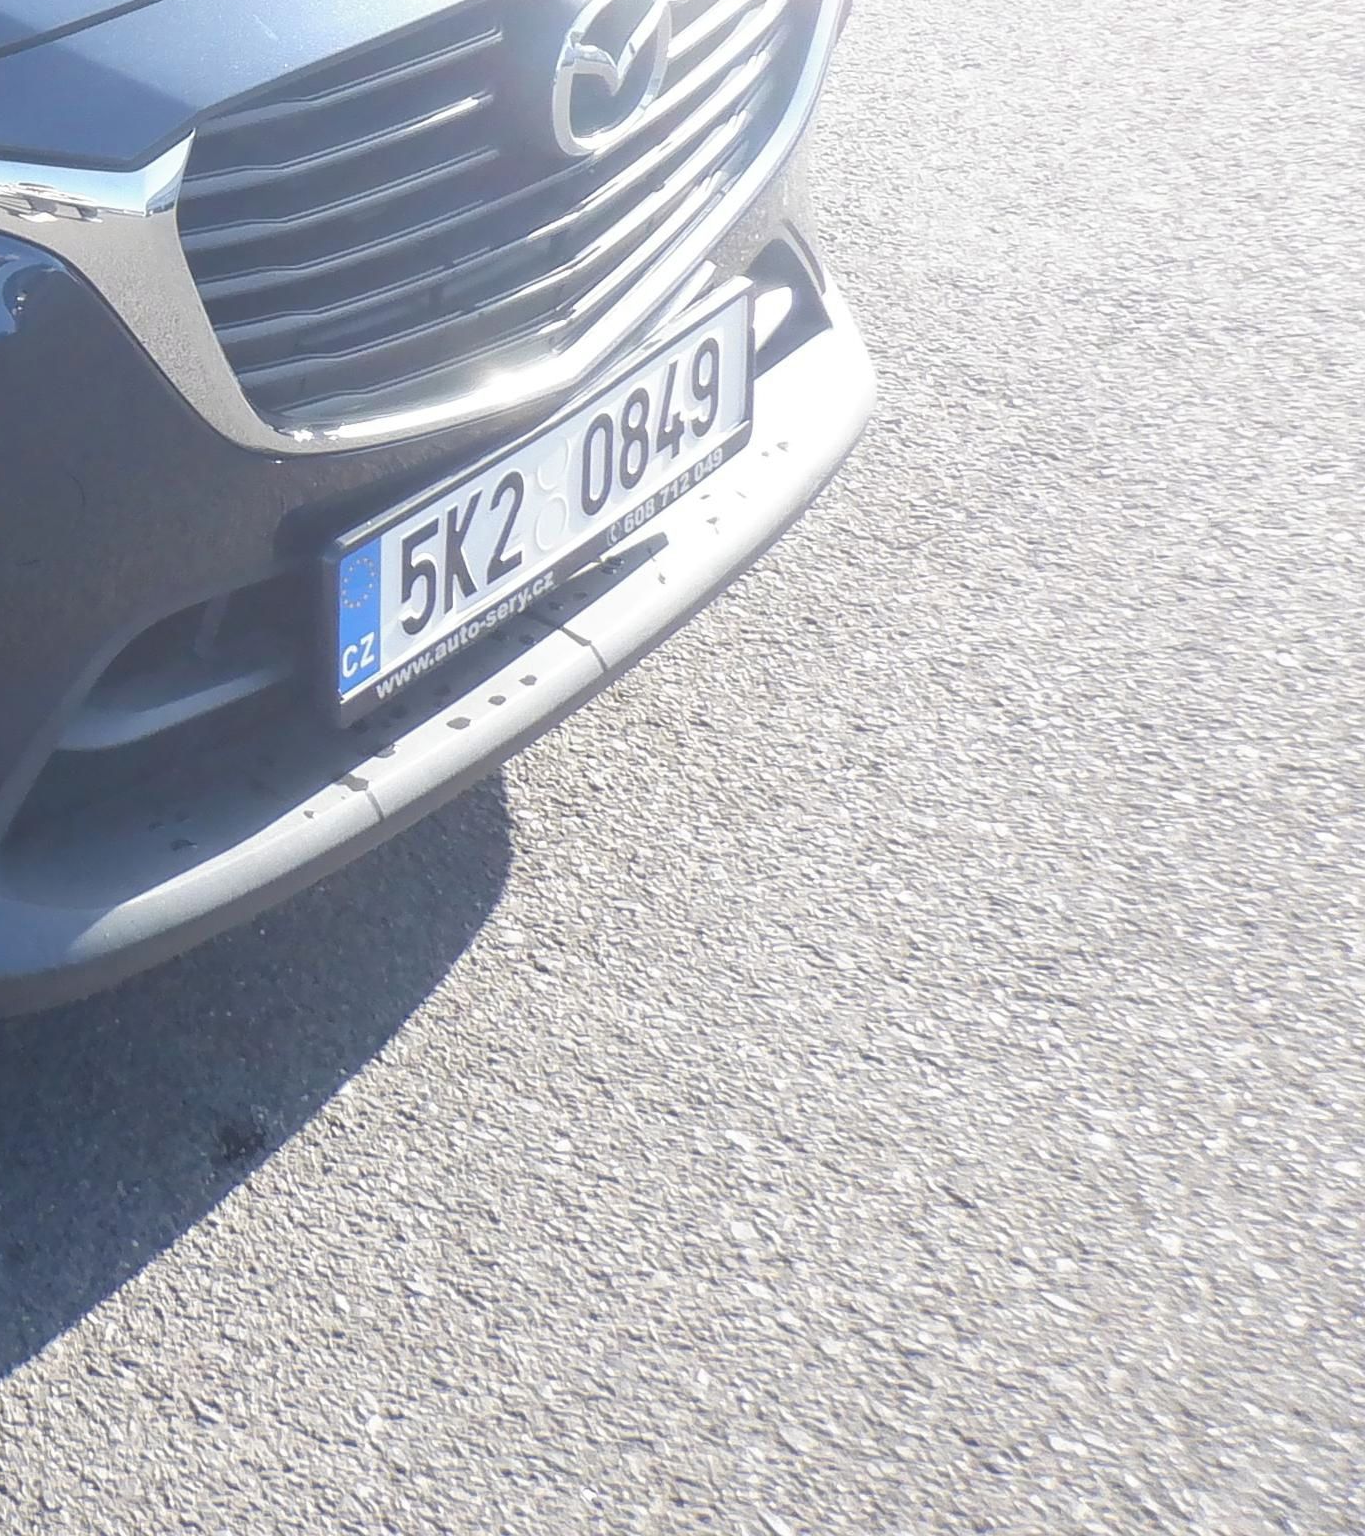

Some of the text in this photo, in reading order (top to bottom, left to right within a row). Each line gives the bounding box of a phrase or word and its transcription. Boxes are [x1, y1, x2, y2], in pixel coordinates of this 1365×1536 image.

[400, 337, 721, 636] 5K2 0849
[624, 447, 724, 534] 608 712 049
[341, 631, 376, 679] CZ
[374, 570, 557, 700] www.auto-sery.cz
